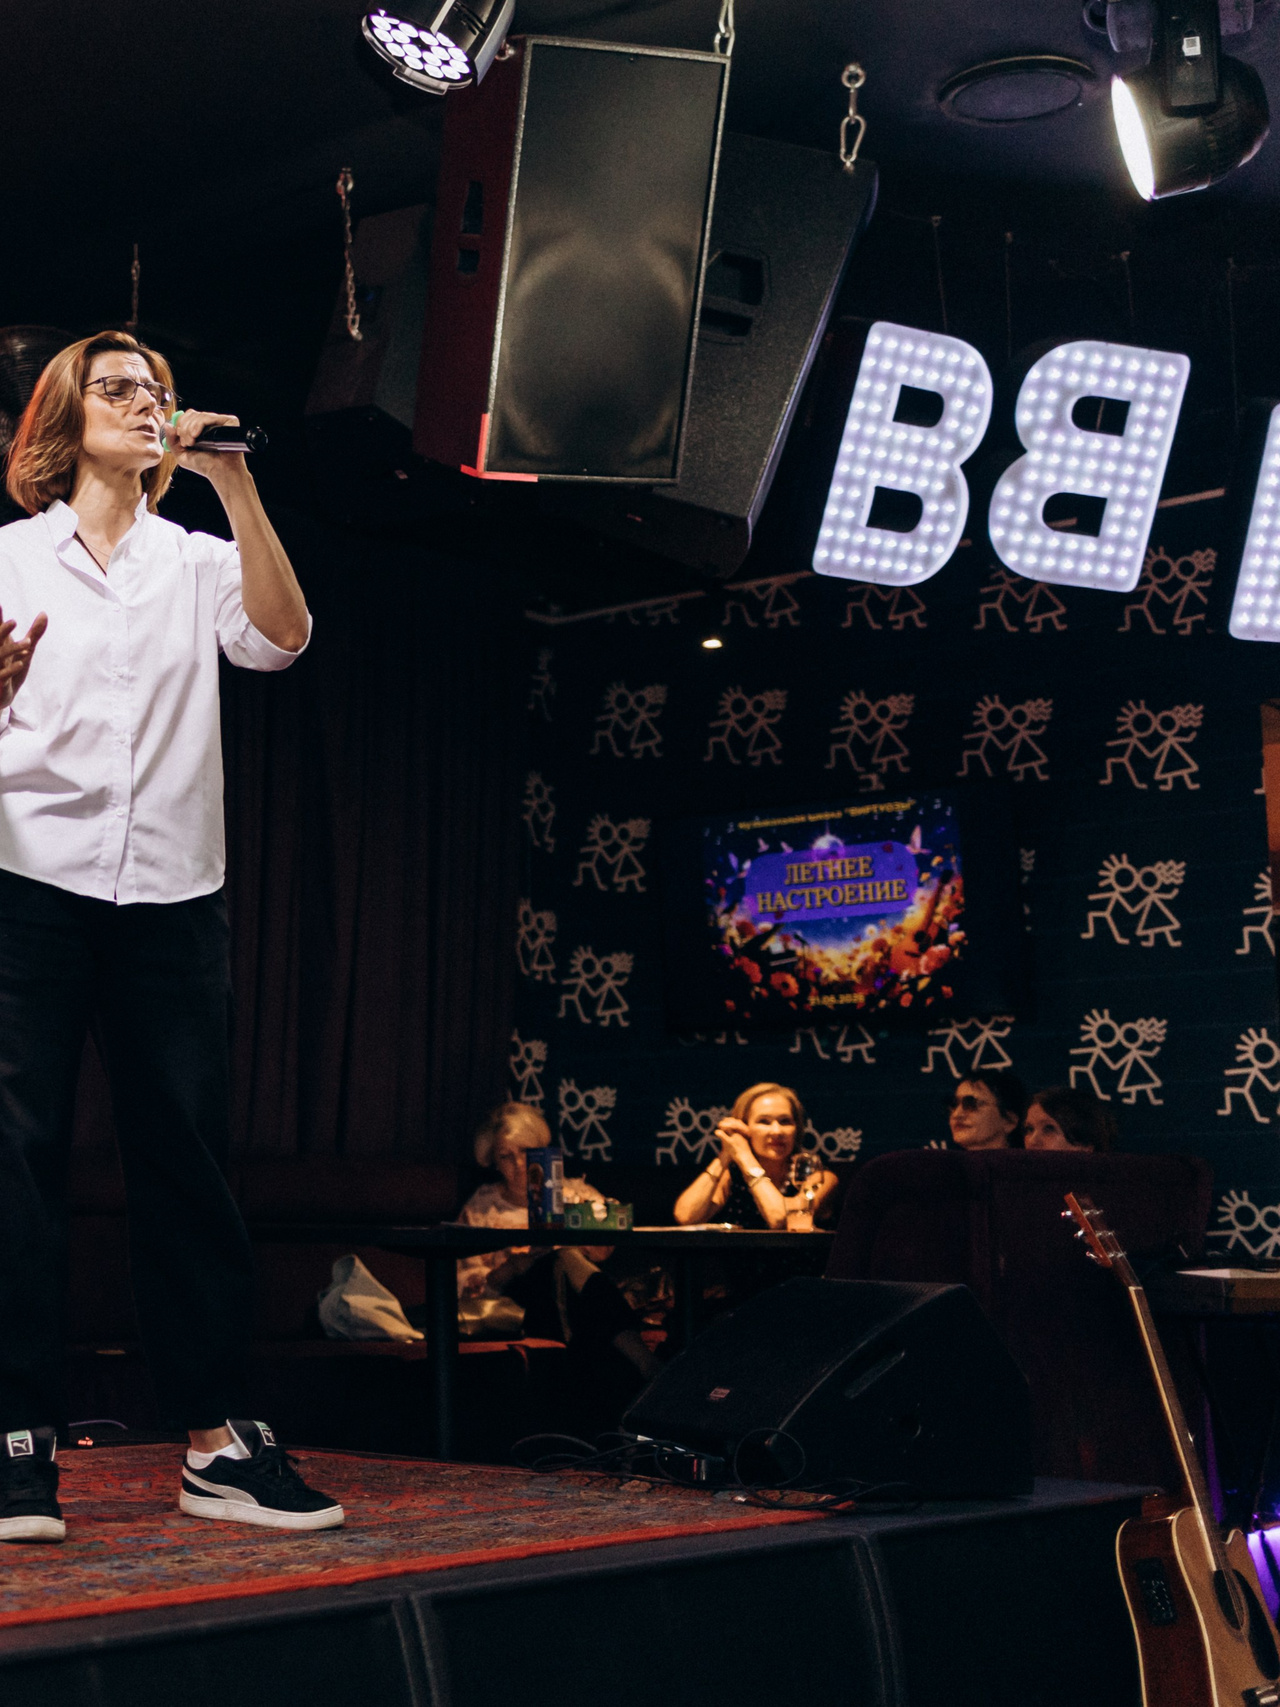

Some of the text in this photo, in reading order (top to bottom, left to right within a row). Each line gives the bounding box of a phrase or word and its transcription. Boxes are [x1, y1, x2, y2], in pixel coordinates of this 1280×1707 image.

[812, 321, 1280, 643] ВВ
[784, 856, 873, 885] ЛЕТНЕЕ
[756, 879, 907, 913] НАСТРОЕНИЕ
